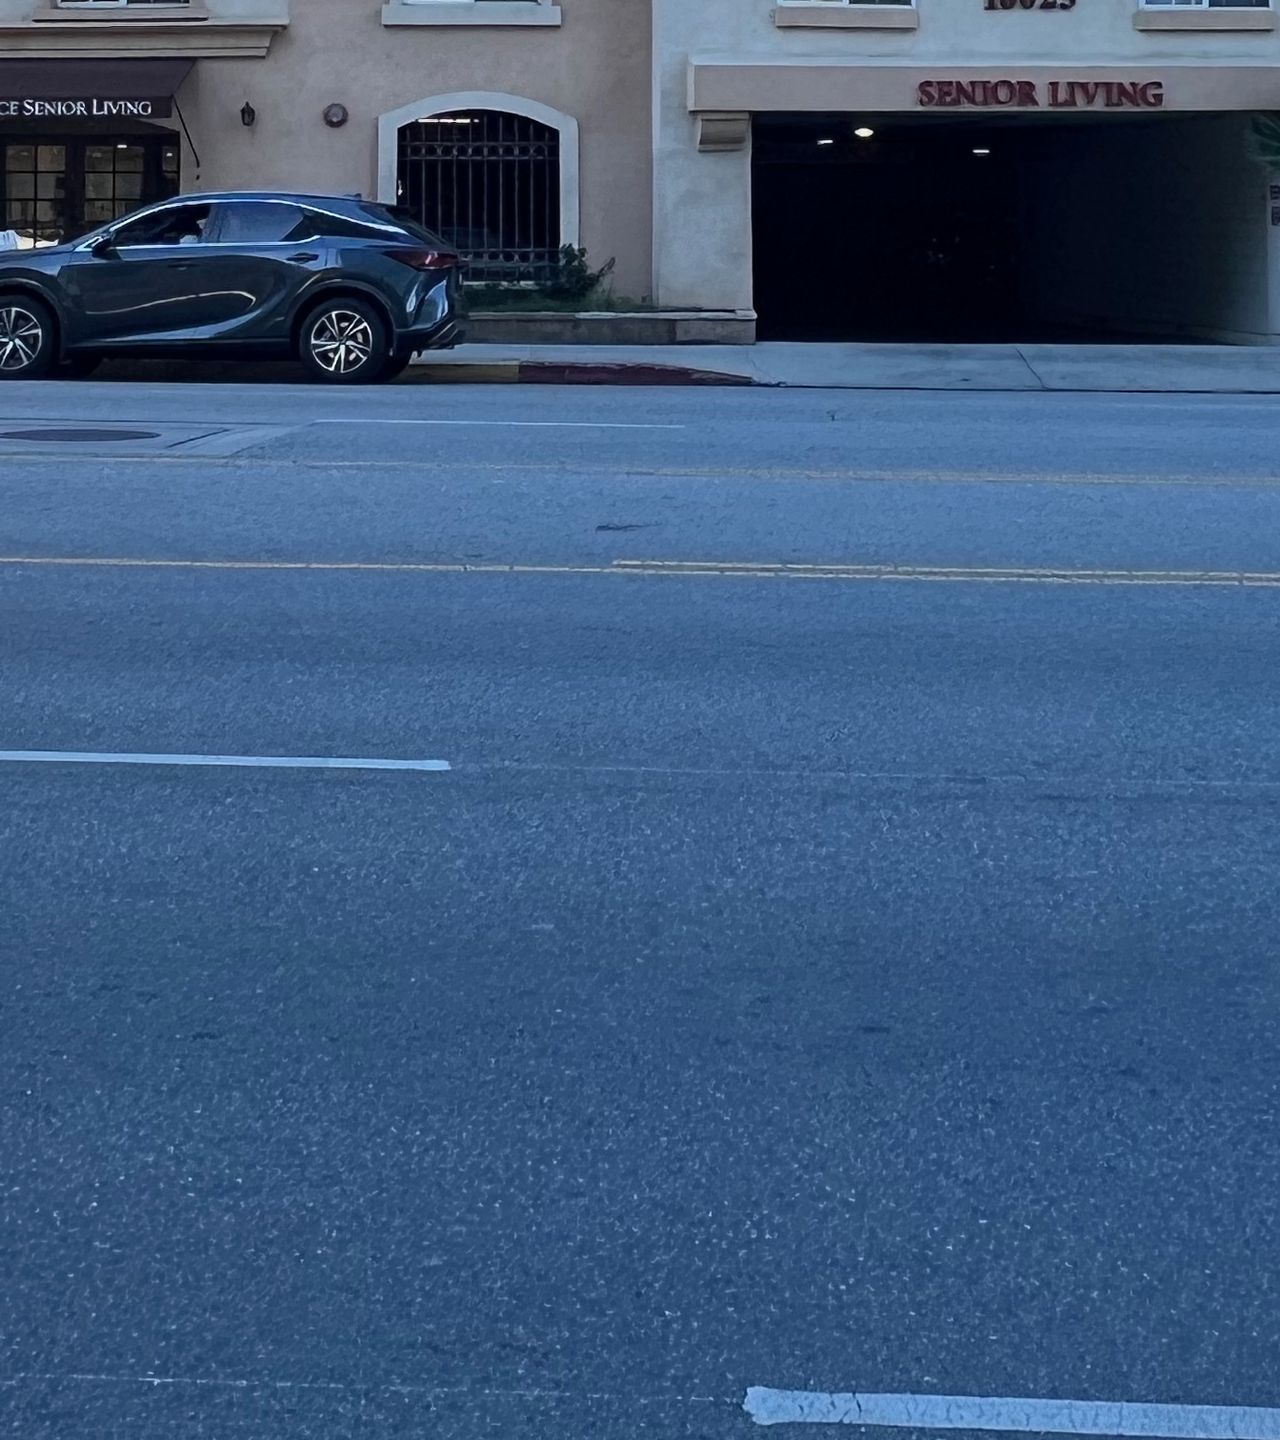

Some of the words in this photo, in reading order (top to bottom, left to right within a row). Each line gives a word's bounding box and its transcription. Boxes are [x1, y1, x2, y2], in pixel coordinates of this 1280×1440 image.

[918, 80, 1039, 107] SENIOR
[1048, 81, 1164, 107] LIVING
[23, 99, 88, 116] SENIOR
[92, 98, 152, 116] LIVING
